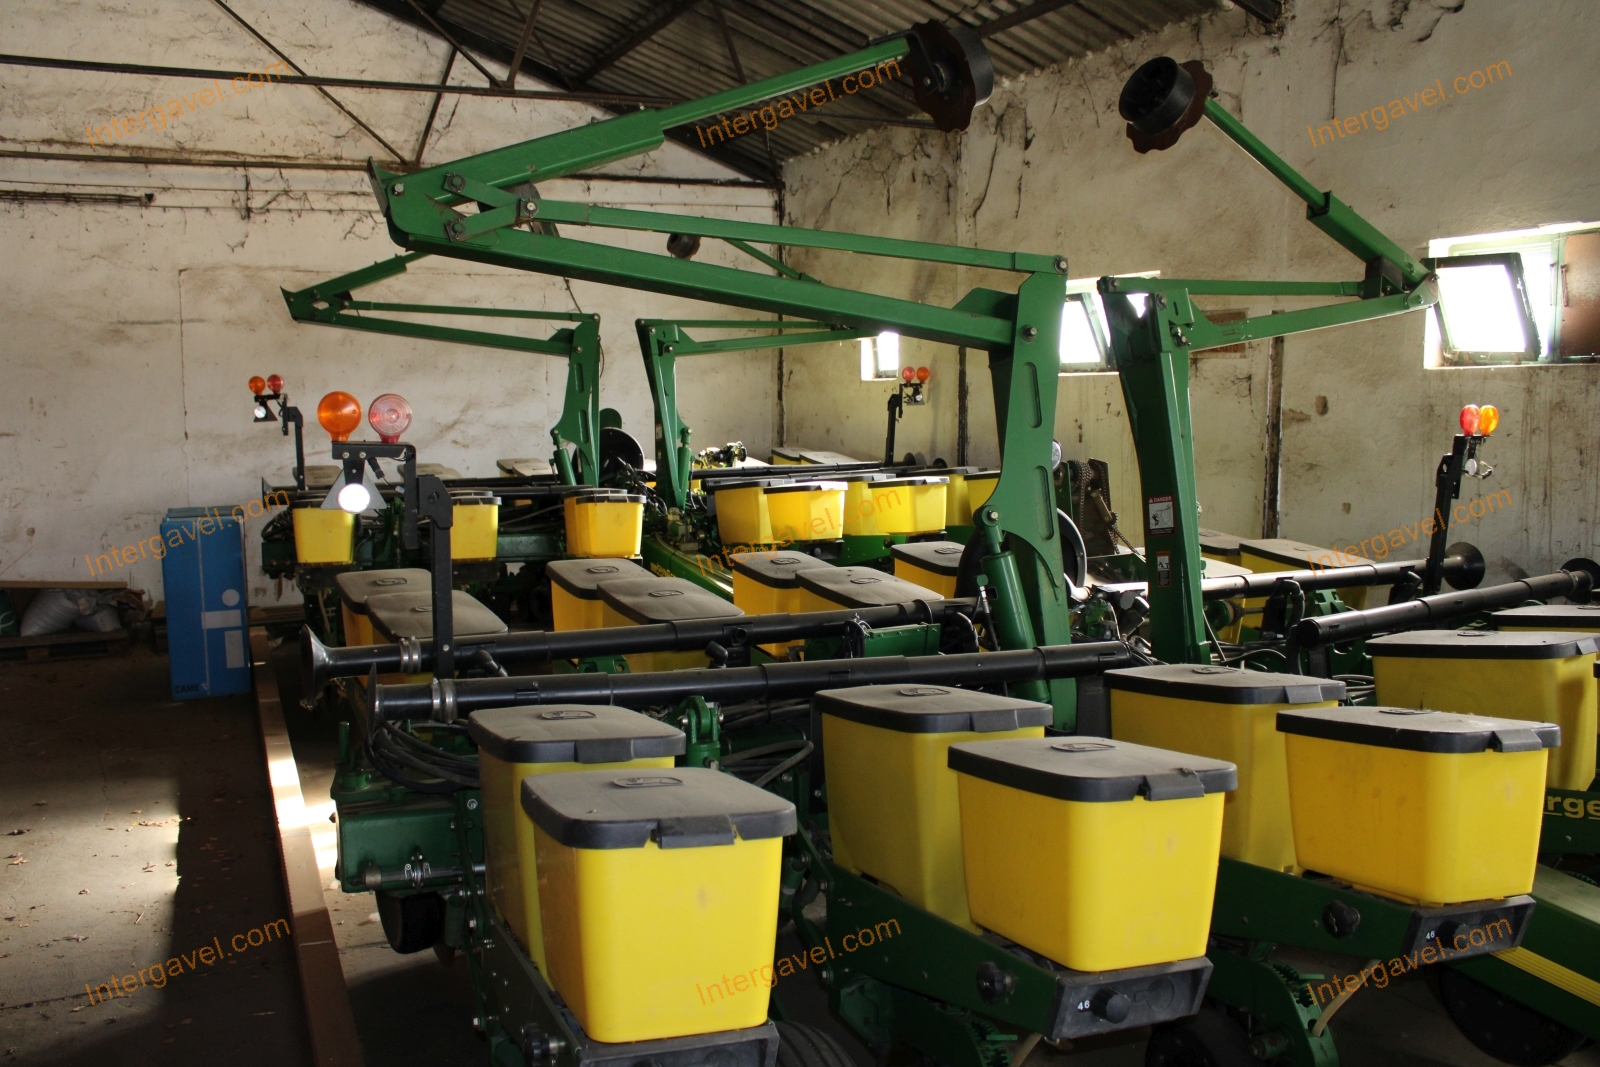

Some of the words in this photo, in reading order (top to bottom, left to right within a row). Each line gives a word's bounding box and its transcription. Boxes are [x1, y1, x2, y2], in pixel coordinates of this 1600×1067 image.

[175, 684, 199, 693] CAME
[1547, 795, 1600, 819] rge
[1077, 999, 1091, 1011] 46
